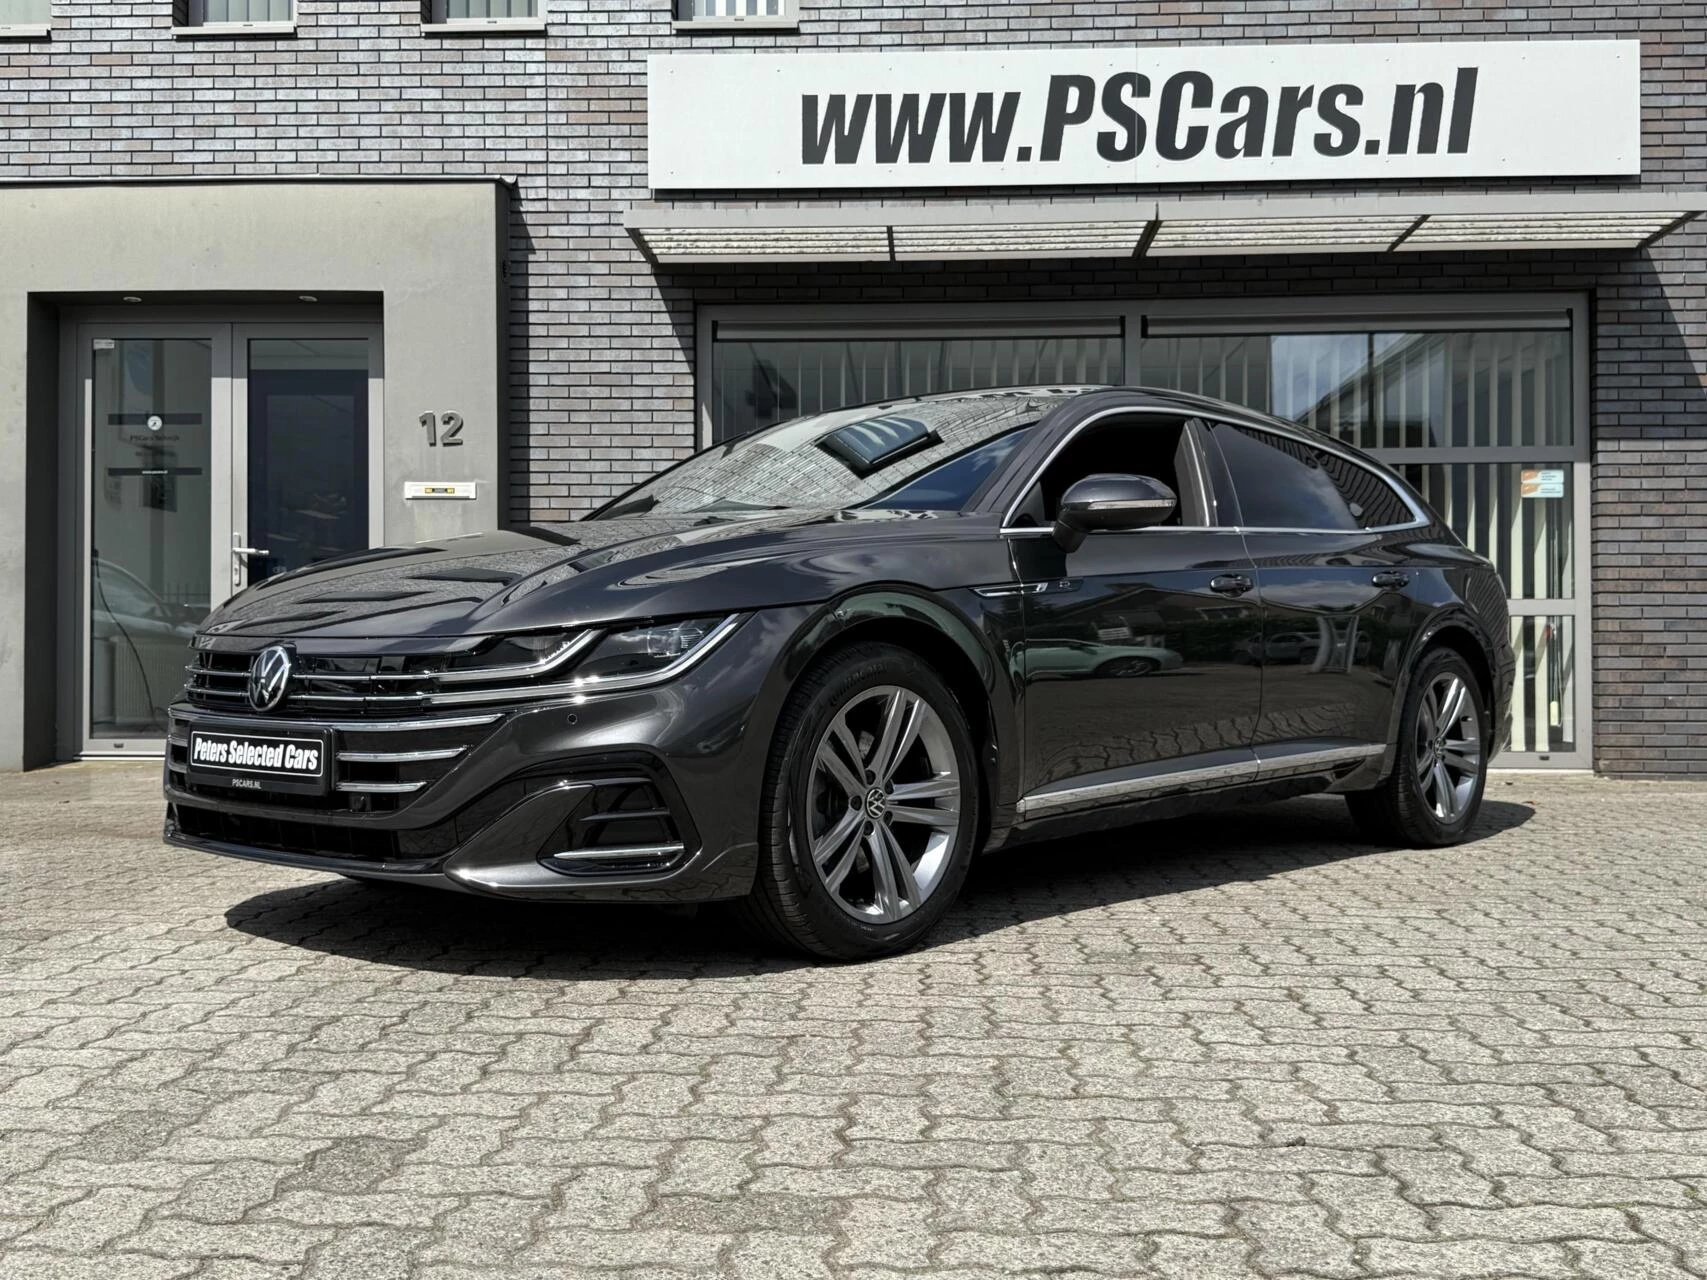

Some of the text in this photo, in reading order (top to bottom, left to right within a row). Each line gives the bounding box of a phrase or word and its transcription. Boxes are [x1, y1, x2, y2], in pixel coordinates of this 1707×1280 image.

[802, 66, 1479, 165] www.PSCars.nl
[418, 410, 465, 447] 12
[194, 737, 319, 770] Peters Selected Cars
